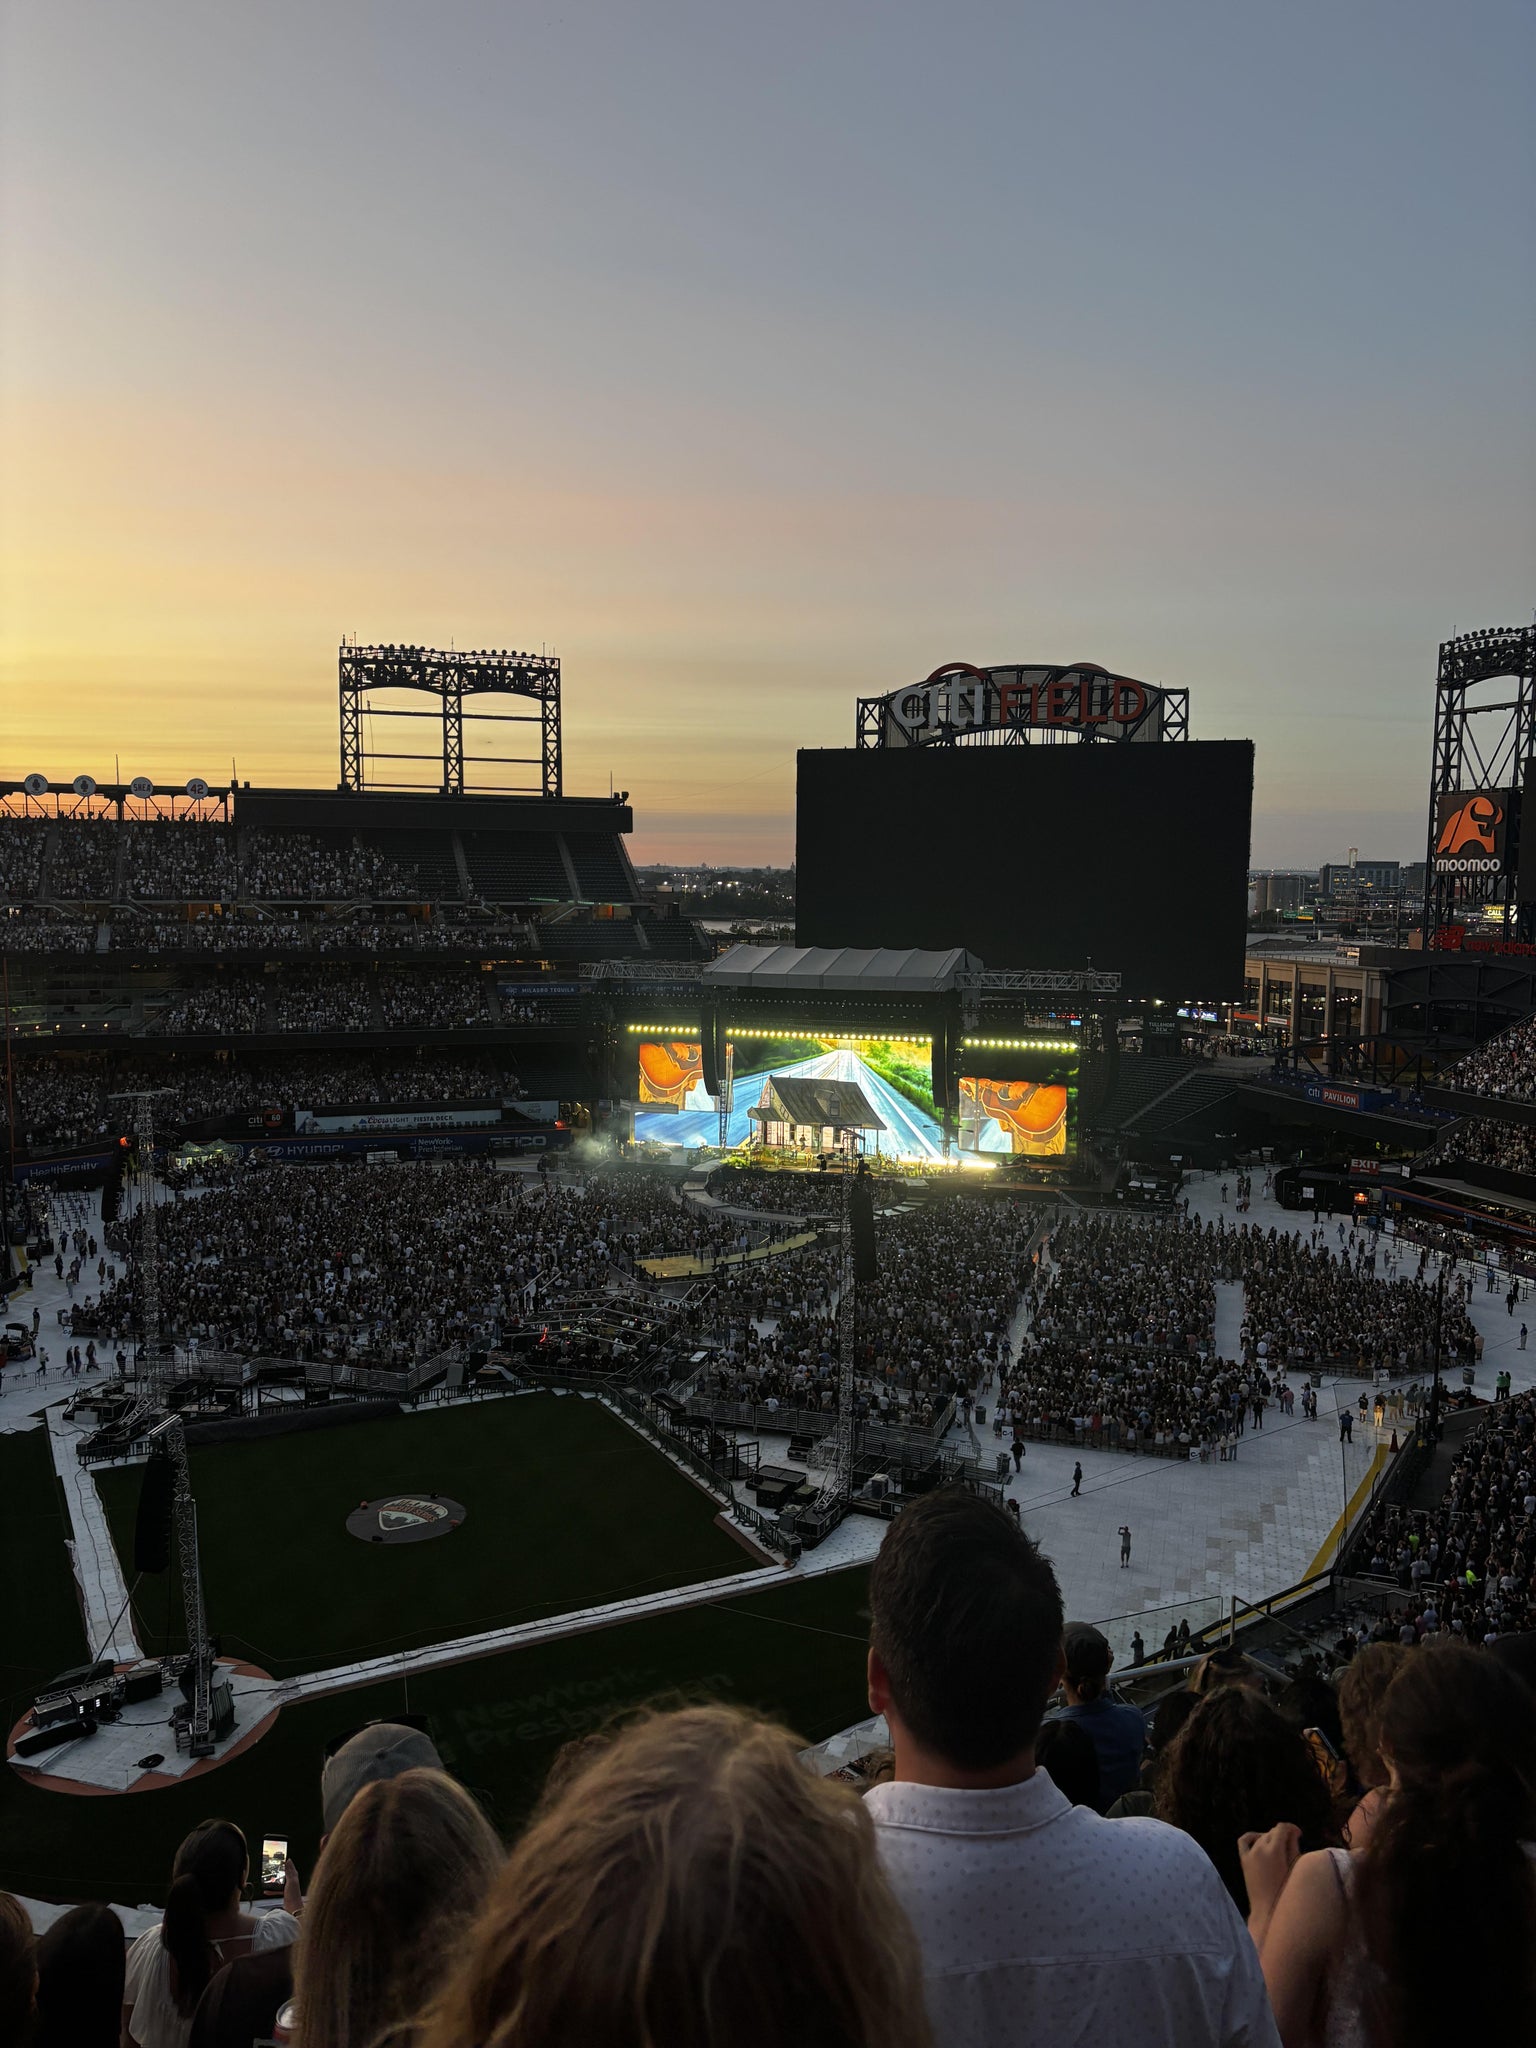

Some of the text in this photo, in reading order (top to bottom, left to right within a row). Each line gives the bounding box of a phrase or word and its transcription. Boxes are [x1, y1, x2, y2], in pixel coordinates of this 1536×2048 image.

[1001, 680, 1147, 724] FIELD
[133, 783, 151, 792] SHEA
[190, 783, 204, 795] 42
[1436, 858, 1501, 872] moomoo
[1308, 1087, 1357, 1106] citi PAVILION
[1351, 1158, 1380, 1170] EXIT
